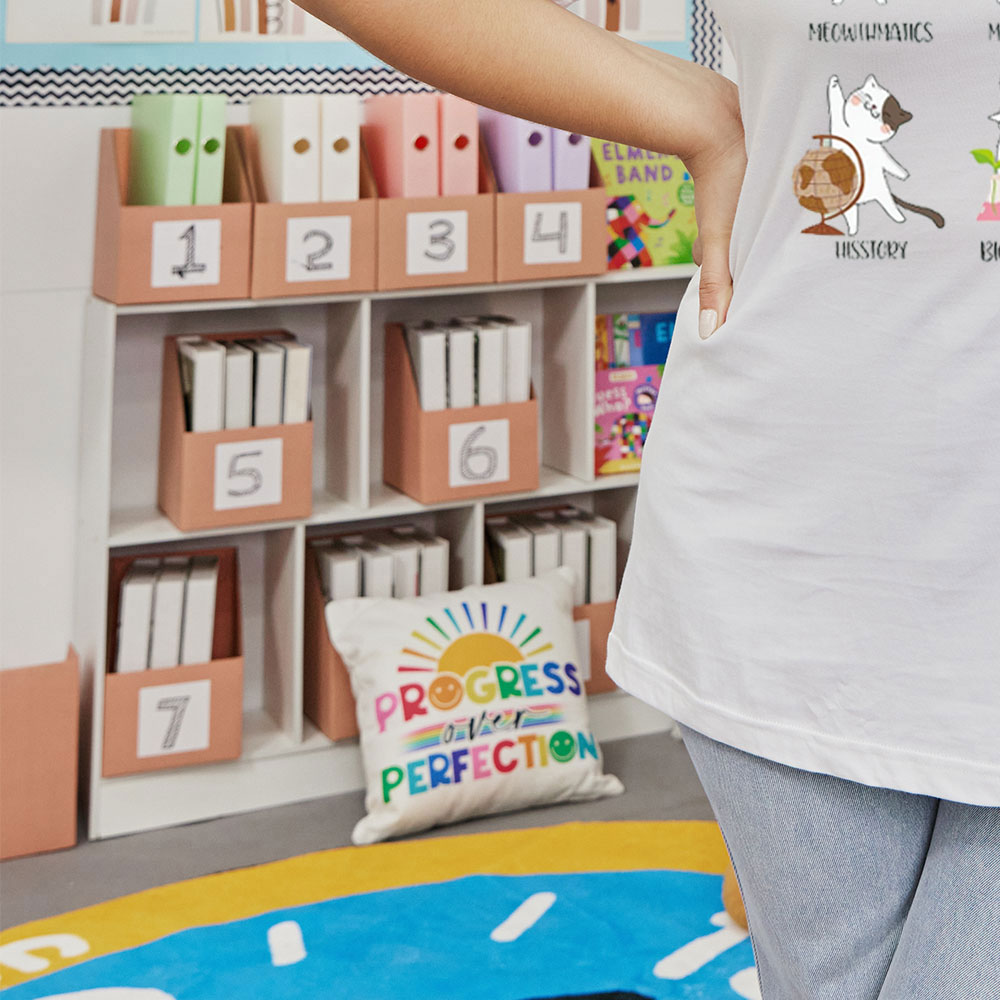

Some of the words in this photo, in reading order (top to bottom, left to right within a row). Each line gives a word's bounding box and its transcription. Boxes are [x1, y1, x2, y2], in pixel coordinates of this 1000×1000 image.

[616, 165, 673, 184] BAND
[171, 224, 207, 279] 1
[302, 229, 335, 271] 2
[424, 218, 456, 261] 3
[531, 211, 568, 254] 4
[835, 241, 908, 260] HISSTORY
[225, 450, 263, 497] 5
[460, 424, 499, 481] 6
[374, 661, 582, 734] PROGRESS
[156, 696, 191, 749] 7
[442, 709, 529, 745] over
[381, 730, 599, 805] PERFECTION
